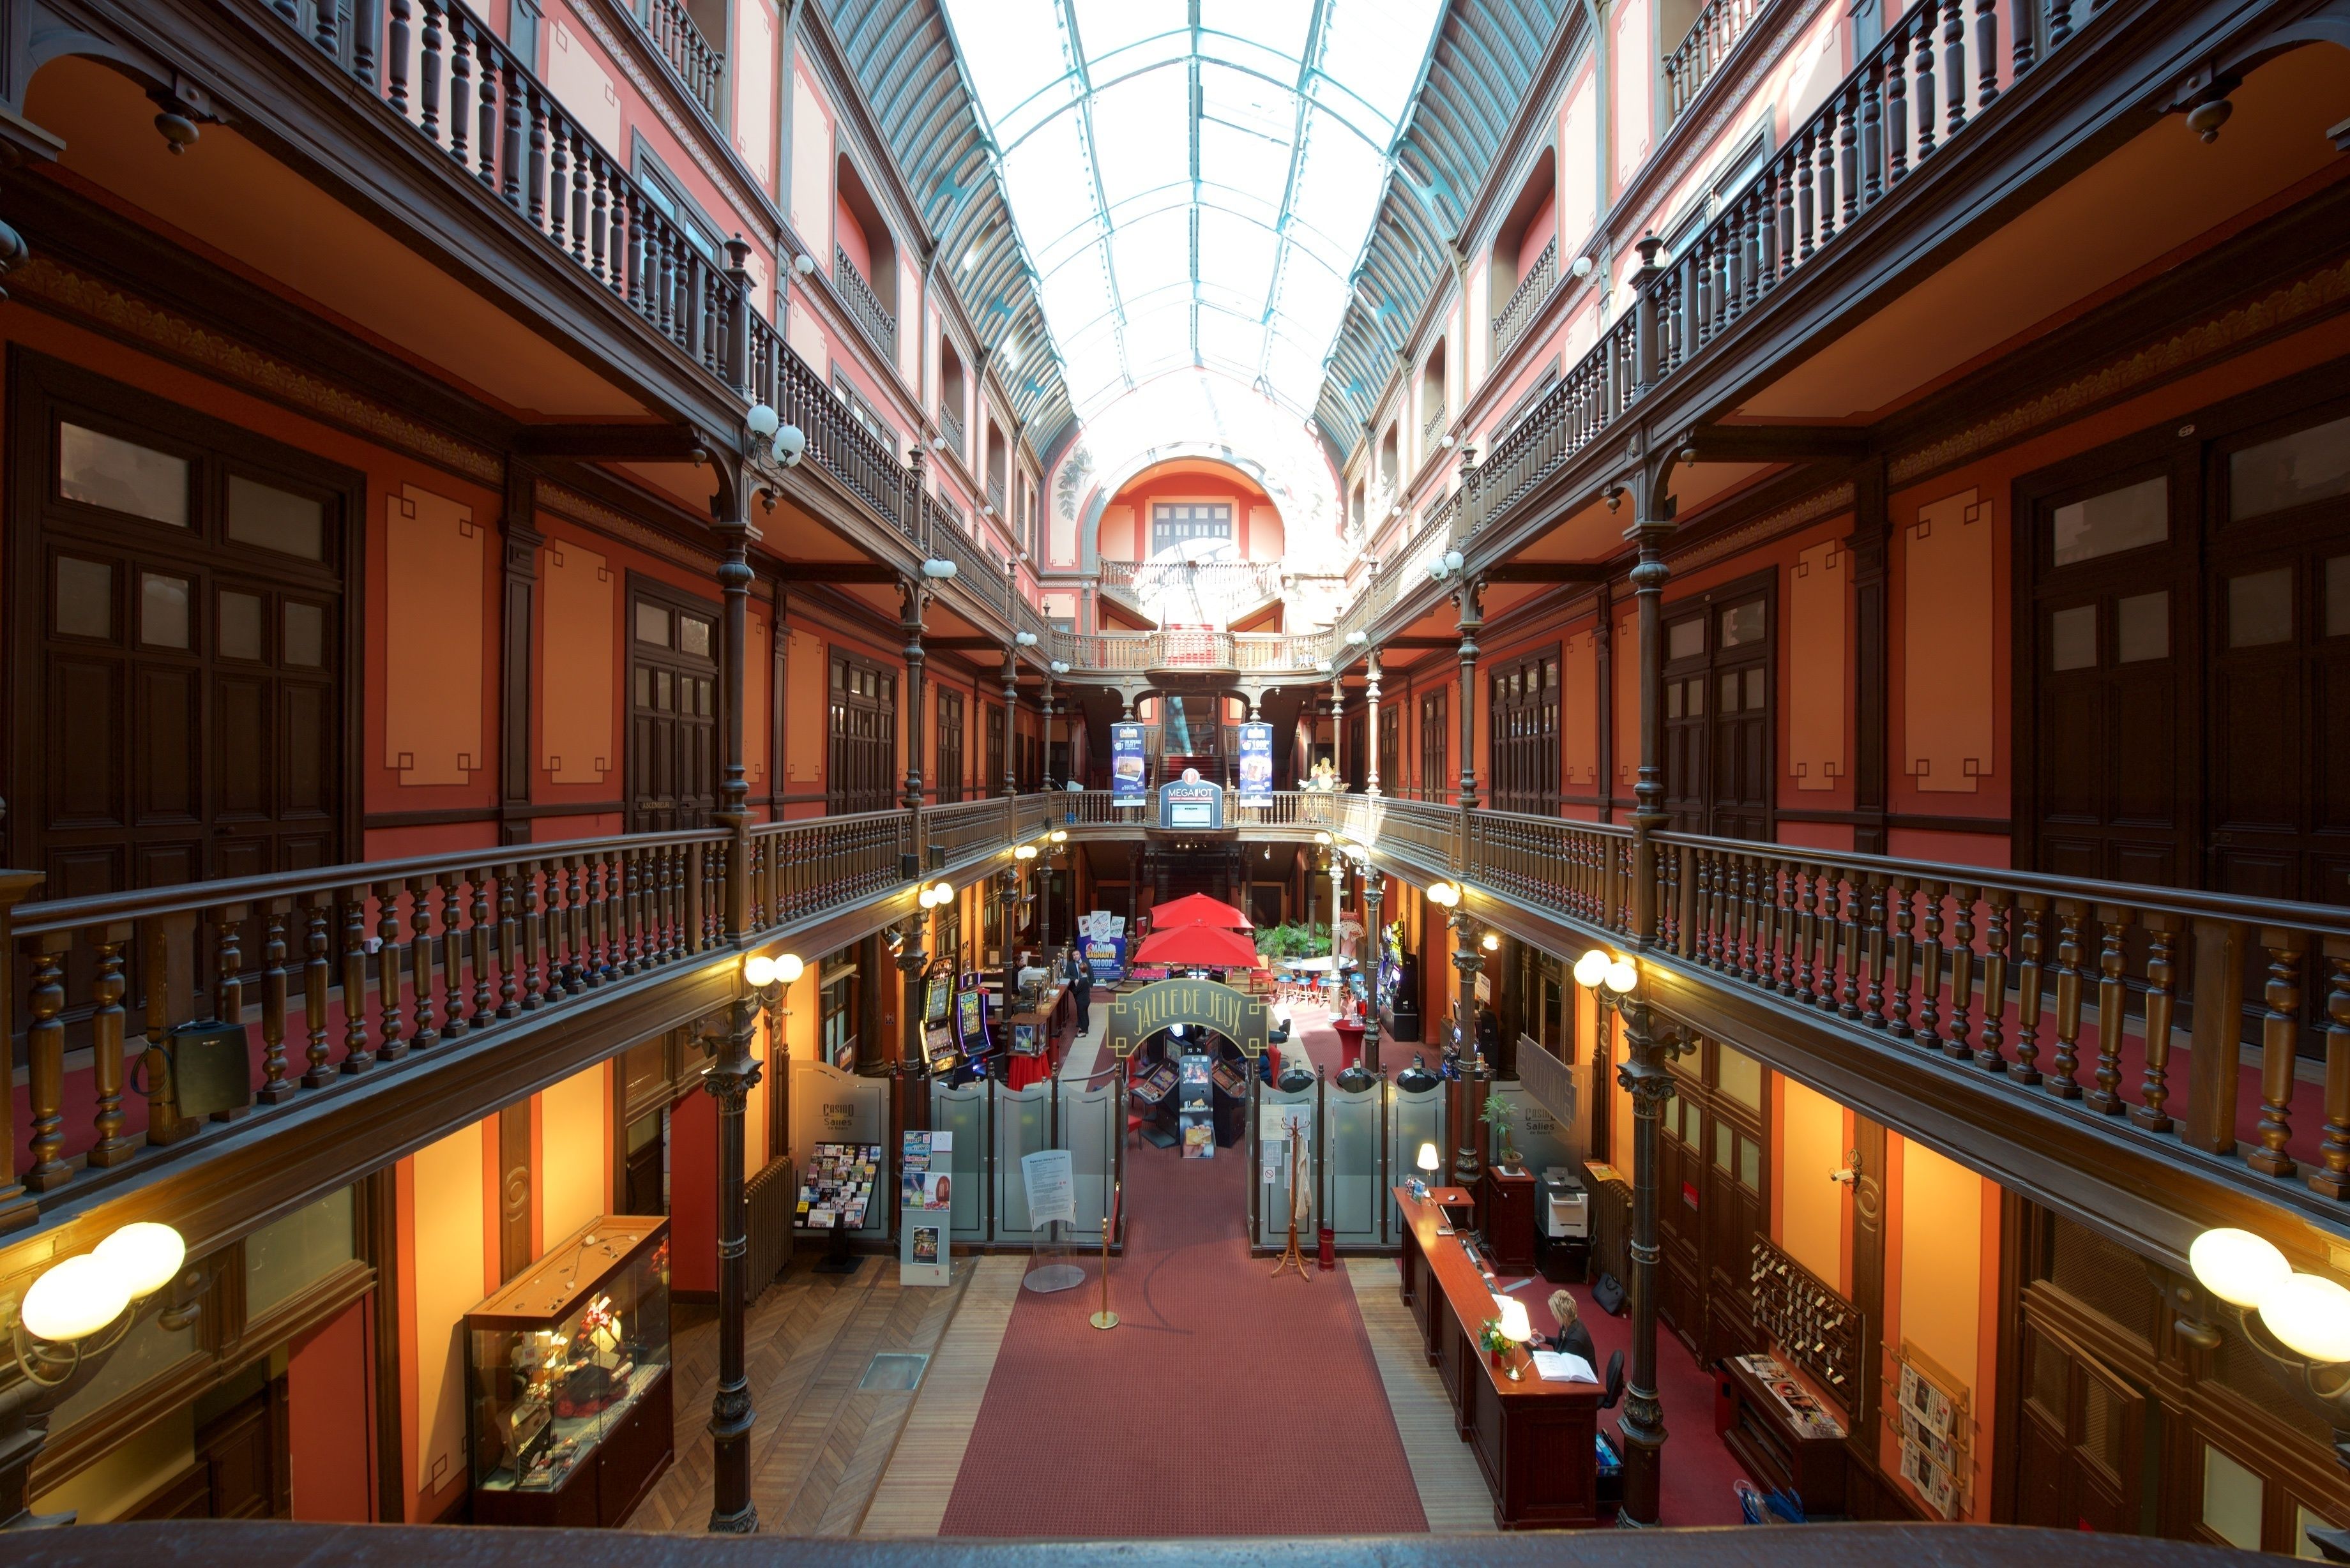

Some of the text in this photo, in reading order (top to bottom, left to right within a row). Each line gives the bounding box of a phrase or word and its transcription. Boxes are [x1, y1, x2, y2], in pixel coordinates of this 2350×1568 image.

[1168, 788, 1213, 797] MEGAPOT
[1133, 989, 1241, 1036] SALLE DE JEUX
